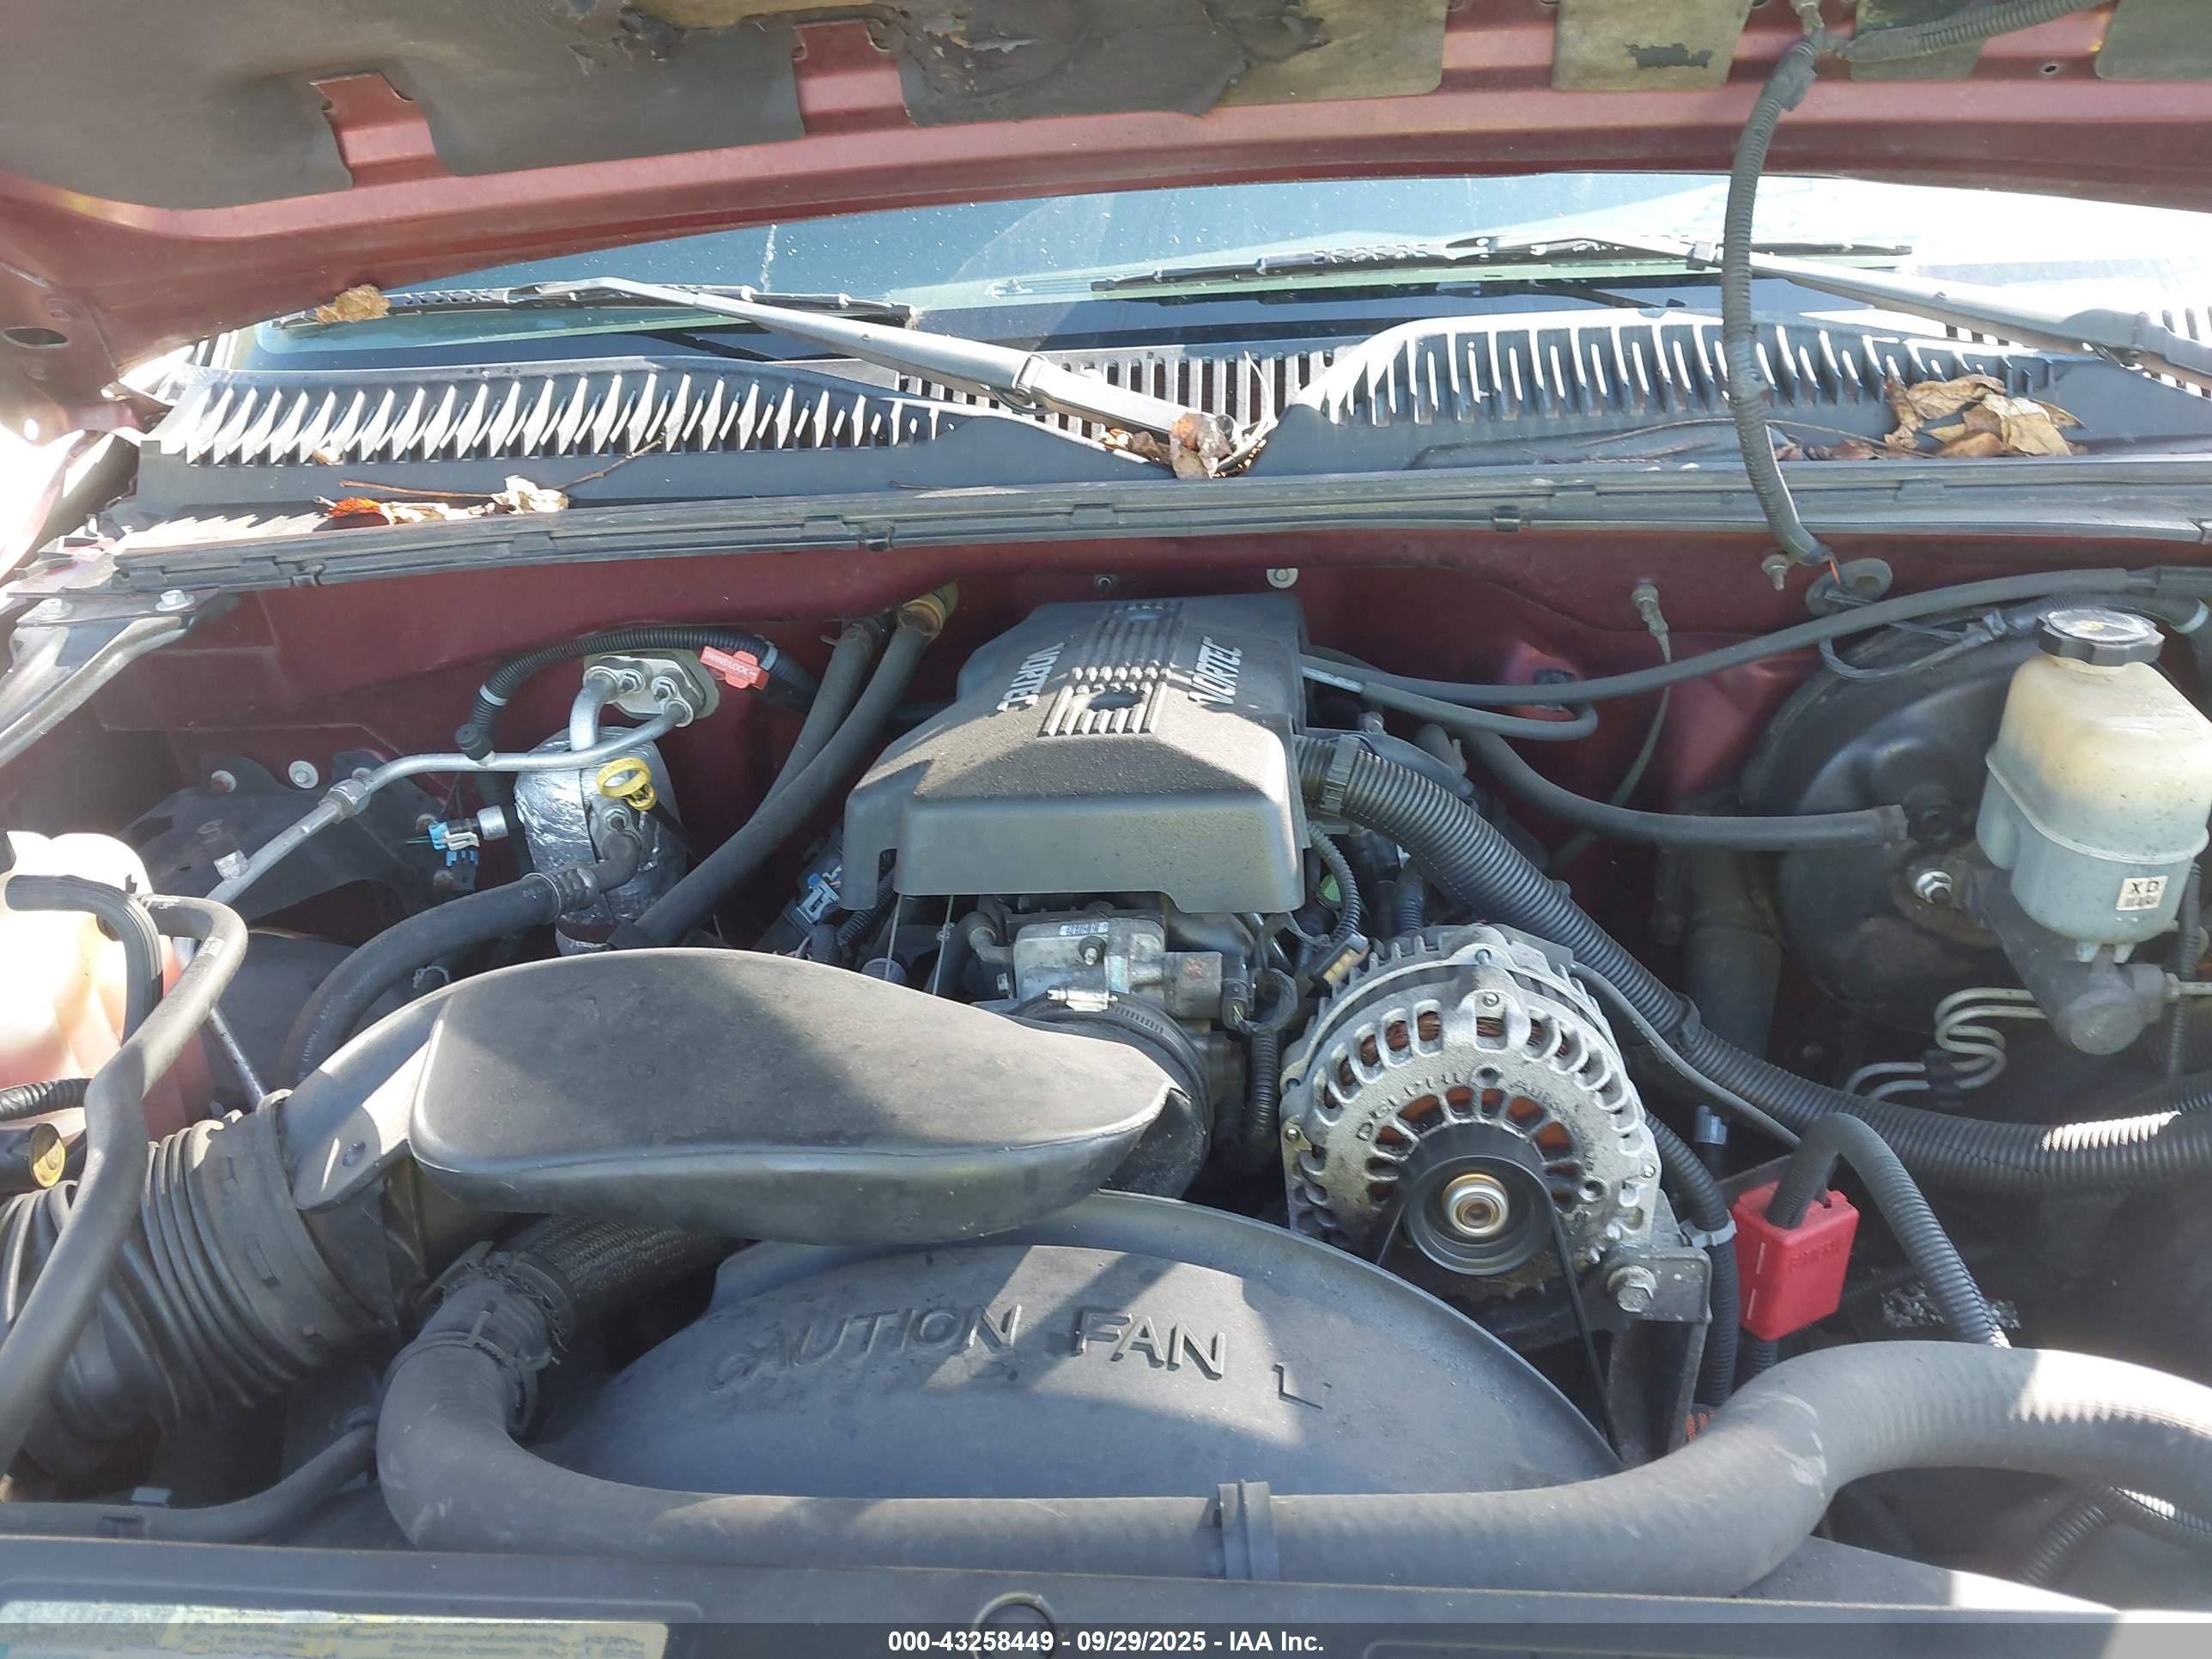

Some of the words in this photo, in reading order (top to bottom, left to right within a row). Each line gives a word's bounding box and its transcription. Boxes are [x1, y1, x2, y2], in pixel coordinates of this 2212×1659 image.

[1188, 635, 1243, 705] VORTEC
[706, 1303, 1024, 1394] CAUTION
[1074, 1307, 1227, 1381] FAN
